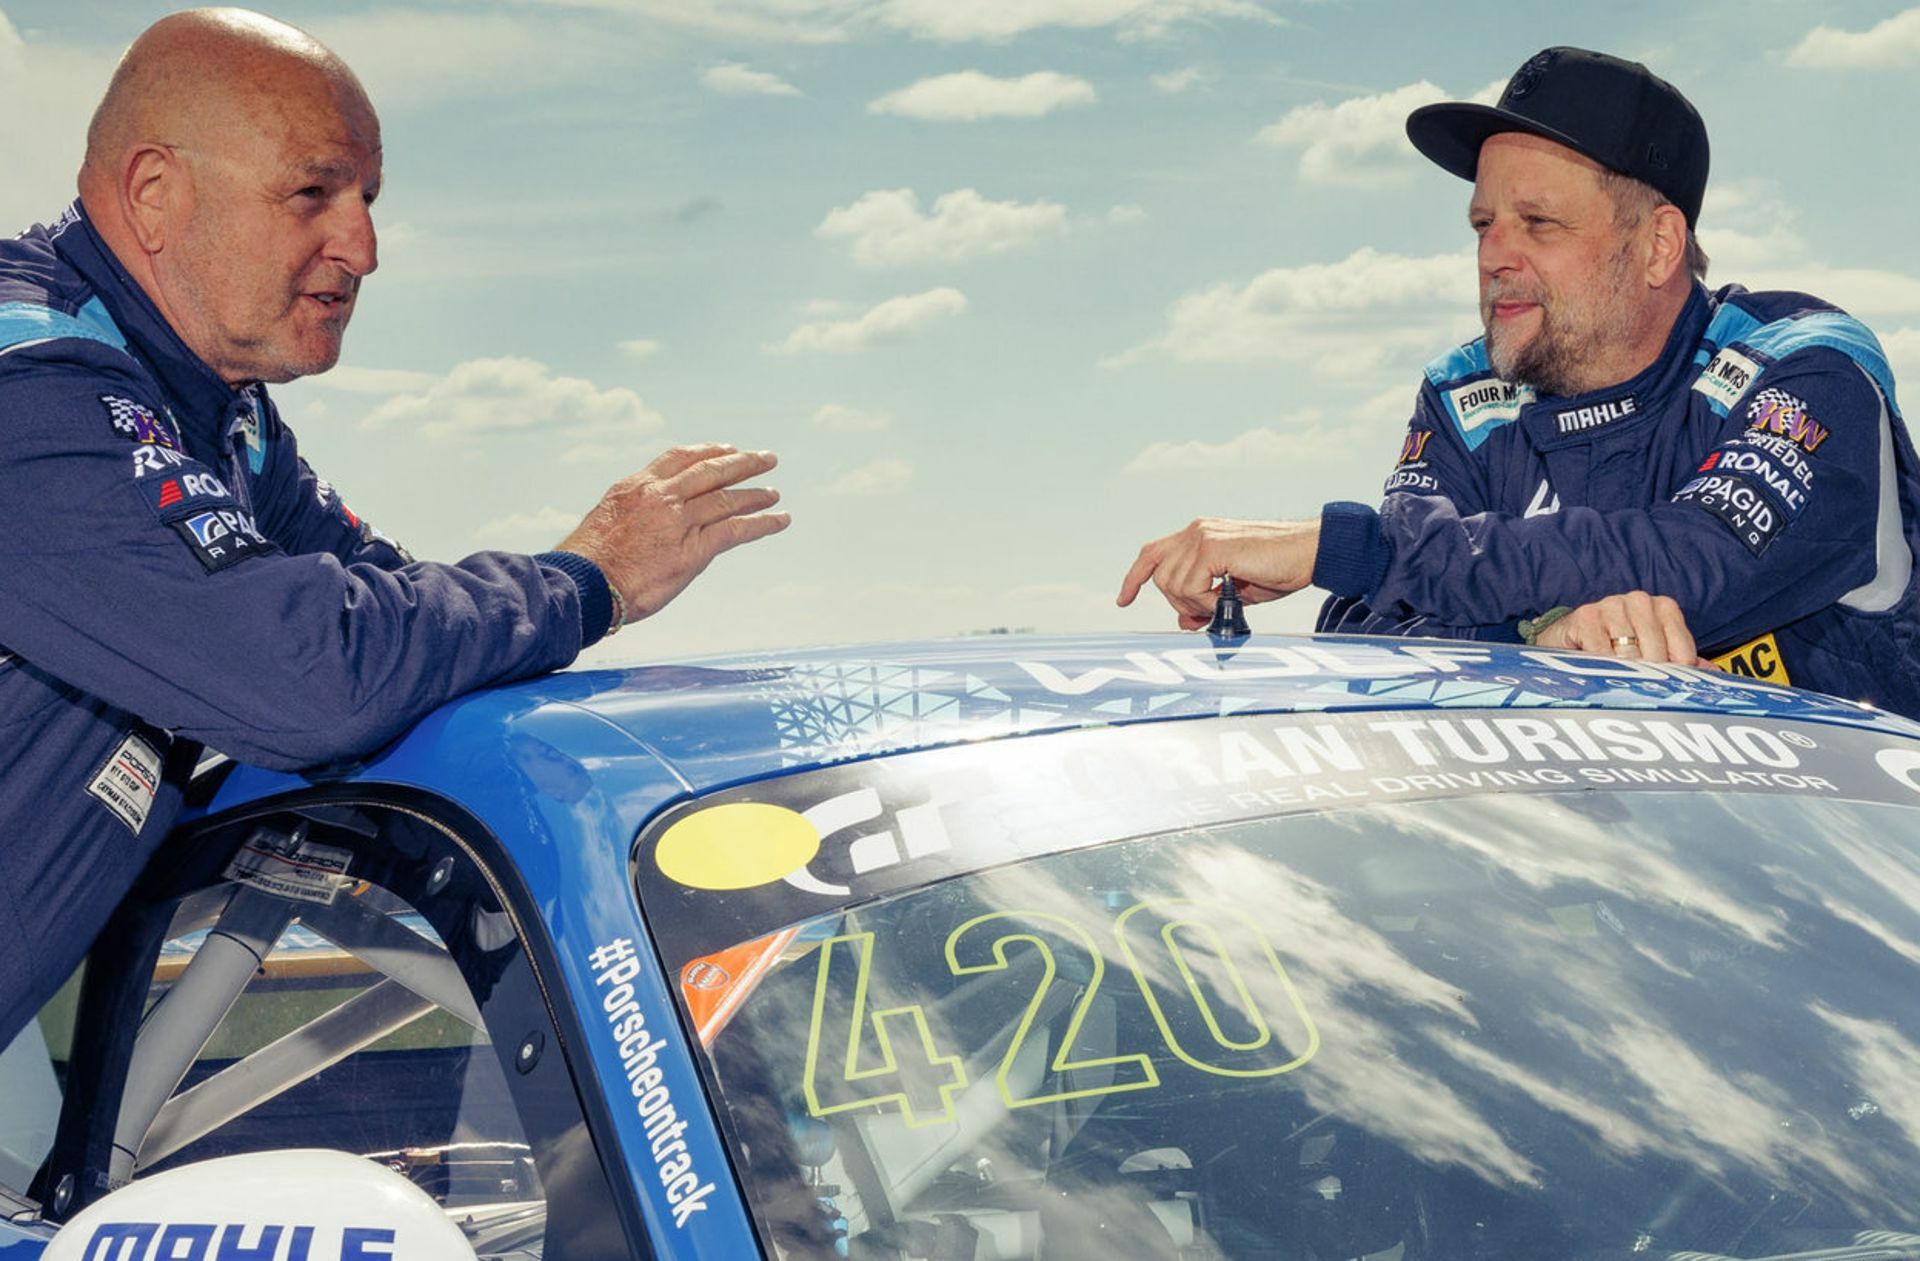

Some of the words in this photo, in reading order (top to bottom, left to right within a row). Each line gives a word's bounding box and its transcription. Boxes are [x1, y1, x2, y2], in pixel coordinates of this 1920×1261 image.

[1459, 387, 1500, 412] FOUR
[1557, 397, 1637, 433] MAHLE
[1752, 400, 1829, 452] KW
[182, 472, 231, 497] RO
[1699, 477, 1773, 532] PAGID
[1718, 451, 1806, 511] RONAL
[208, 537, 248, 559] RA
[1014, 645, 1492, 696] WOLF
[1233, 776, 1369, 810] REAL
[1369, 767, 1577, 795] DRIVING
[1584, 766, 1840, 793] SIMULATOR
[803, 898, 1320, 1129] 420
[588, 938, 716, 1230] #Porscheontrack
